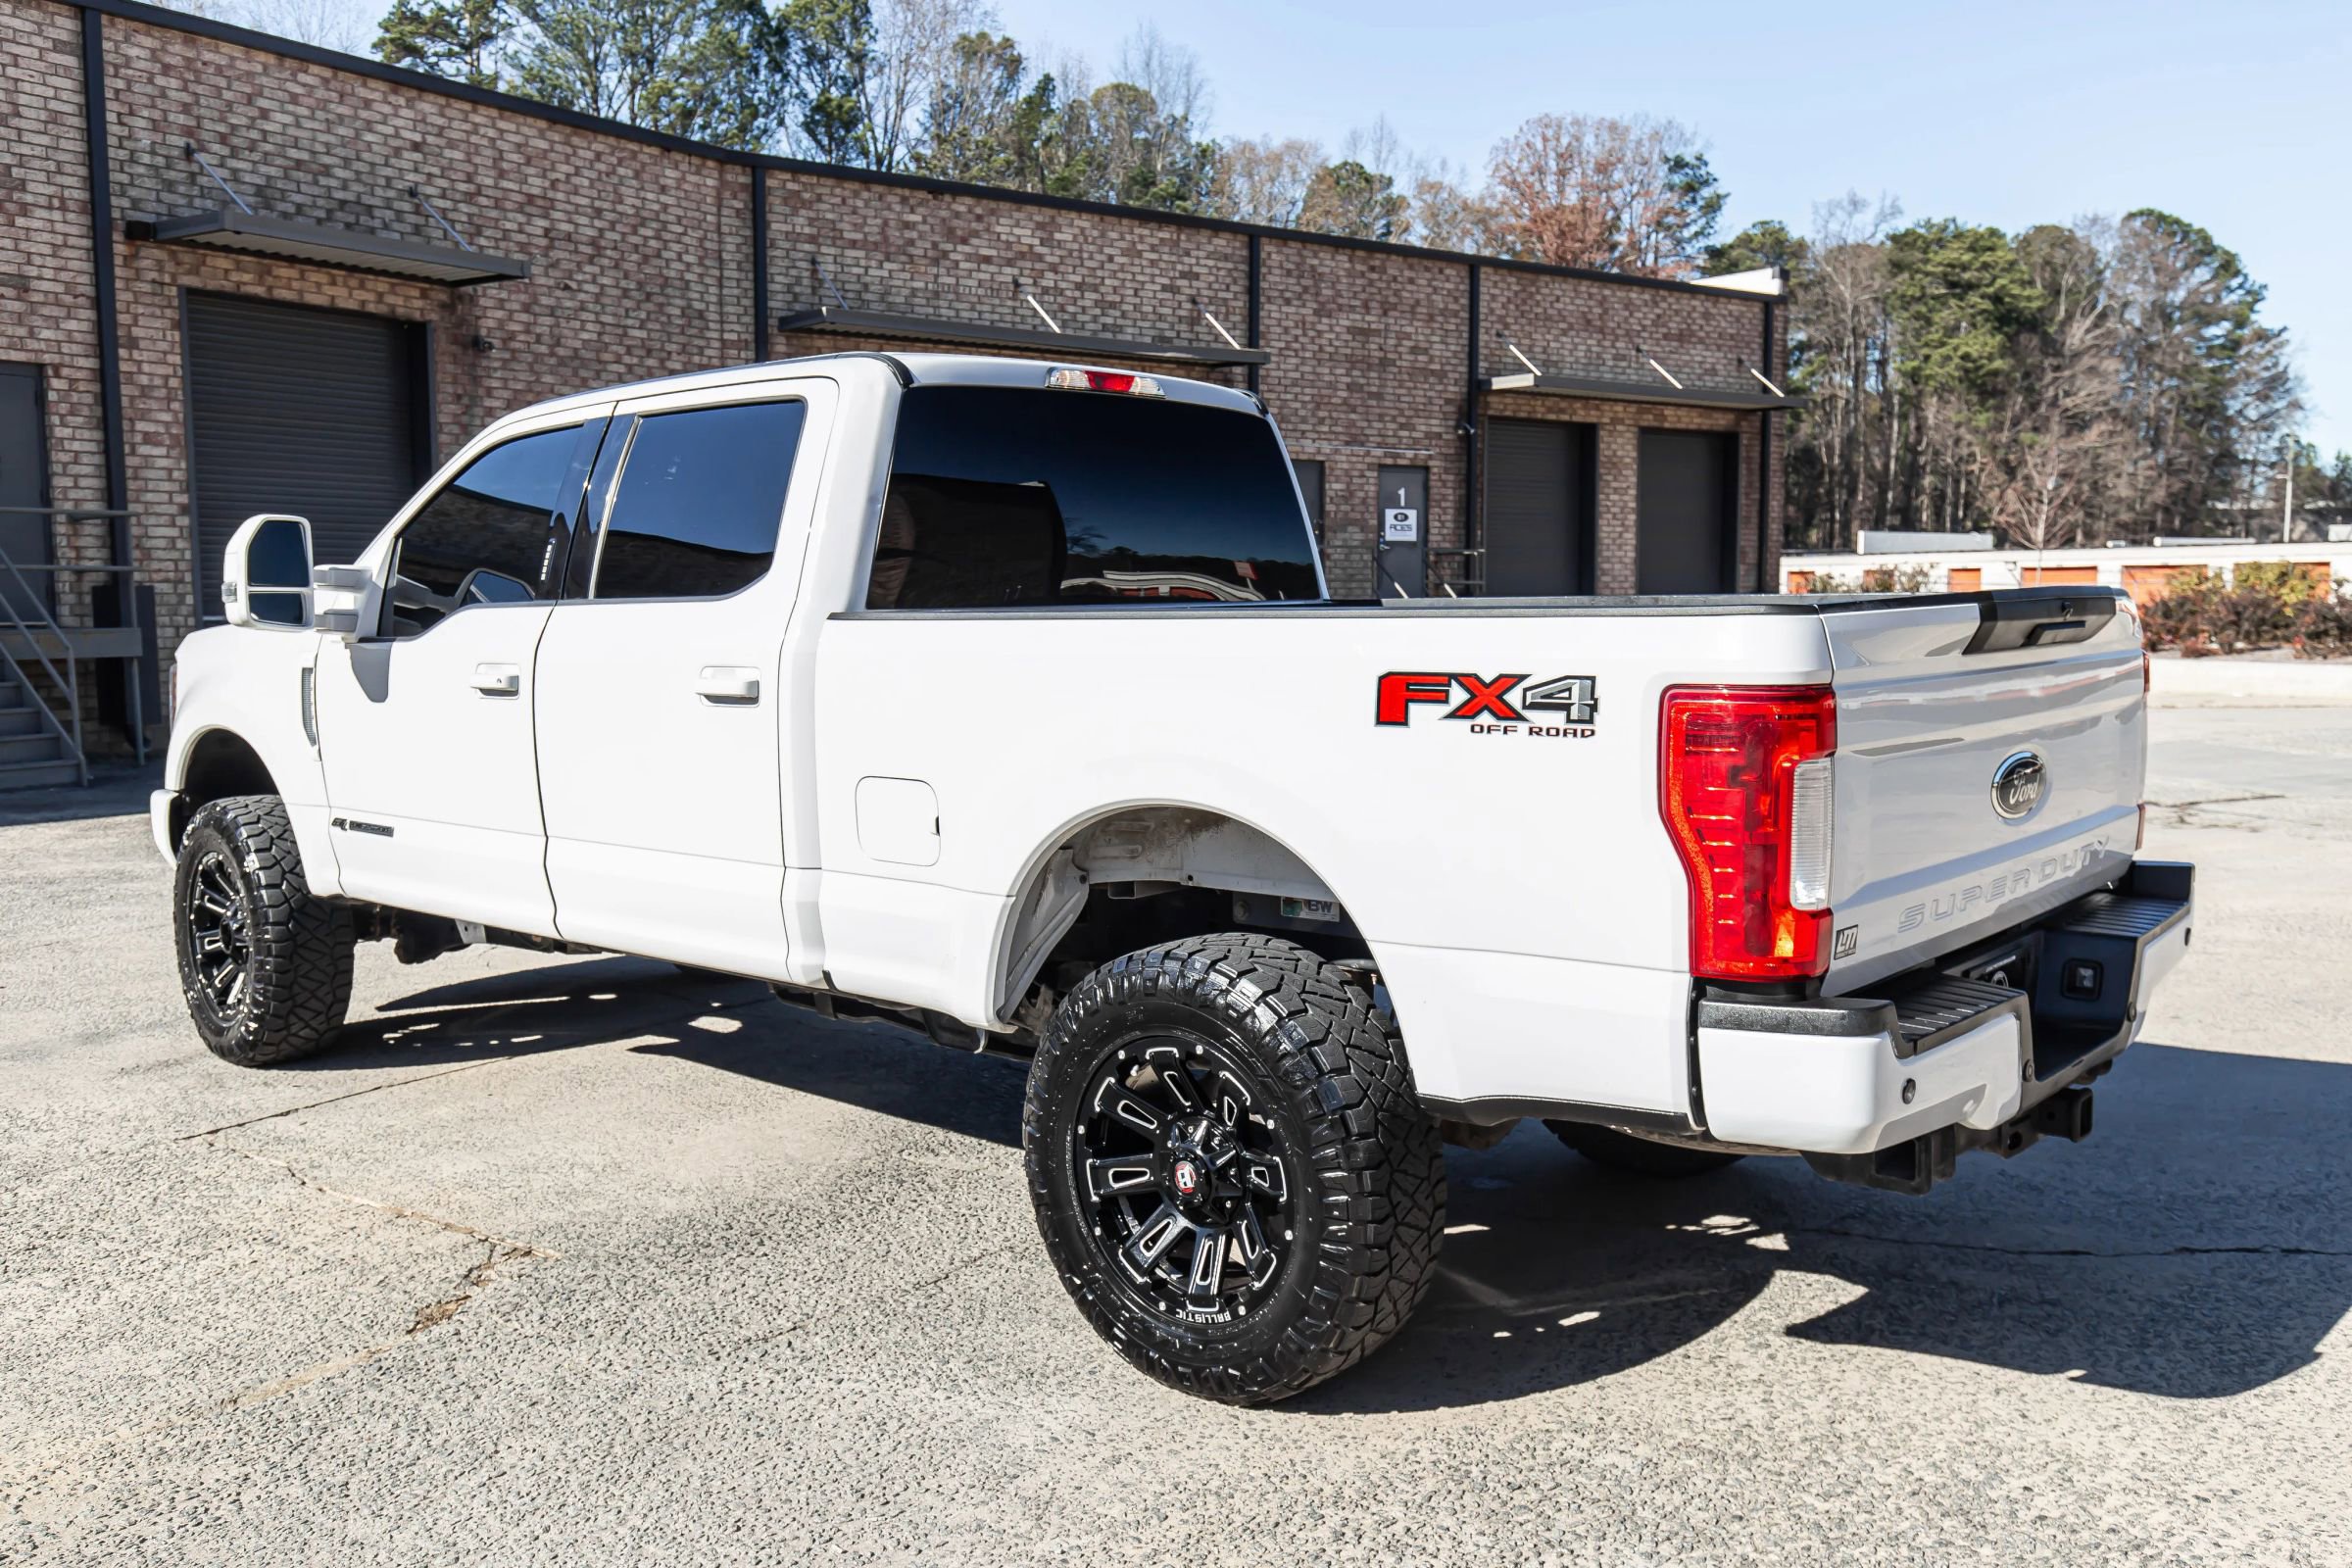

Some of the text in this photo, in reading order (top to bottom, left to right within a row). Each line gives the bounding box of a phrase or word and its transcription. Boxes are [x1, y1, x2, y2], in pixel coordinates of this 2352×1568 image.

[1397, 487, 1406, 508] 1
[1374, 670, 1599, 728] FX4
[1470, 723, 1595, 739] OFF ROAD
[2009, 768, 2040, 805] Ford
[1897, 835, 2110, 934] SUPER DUTY
[1175, 1308, 1232, 1324] BALLISTIC
